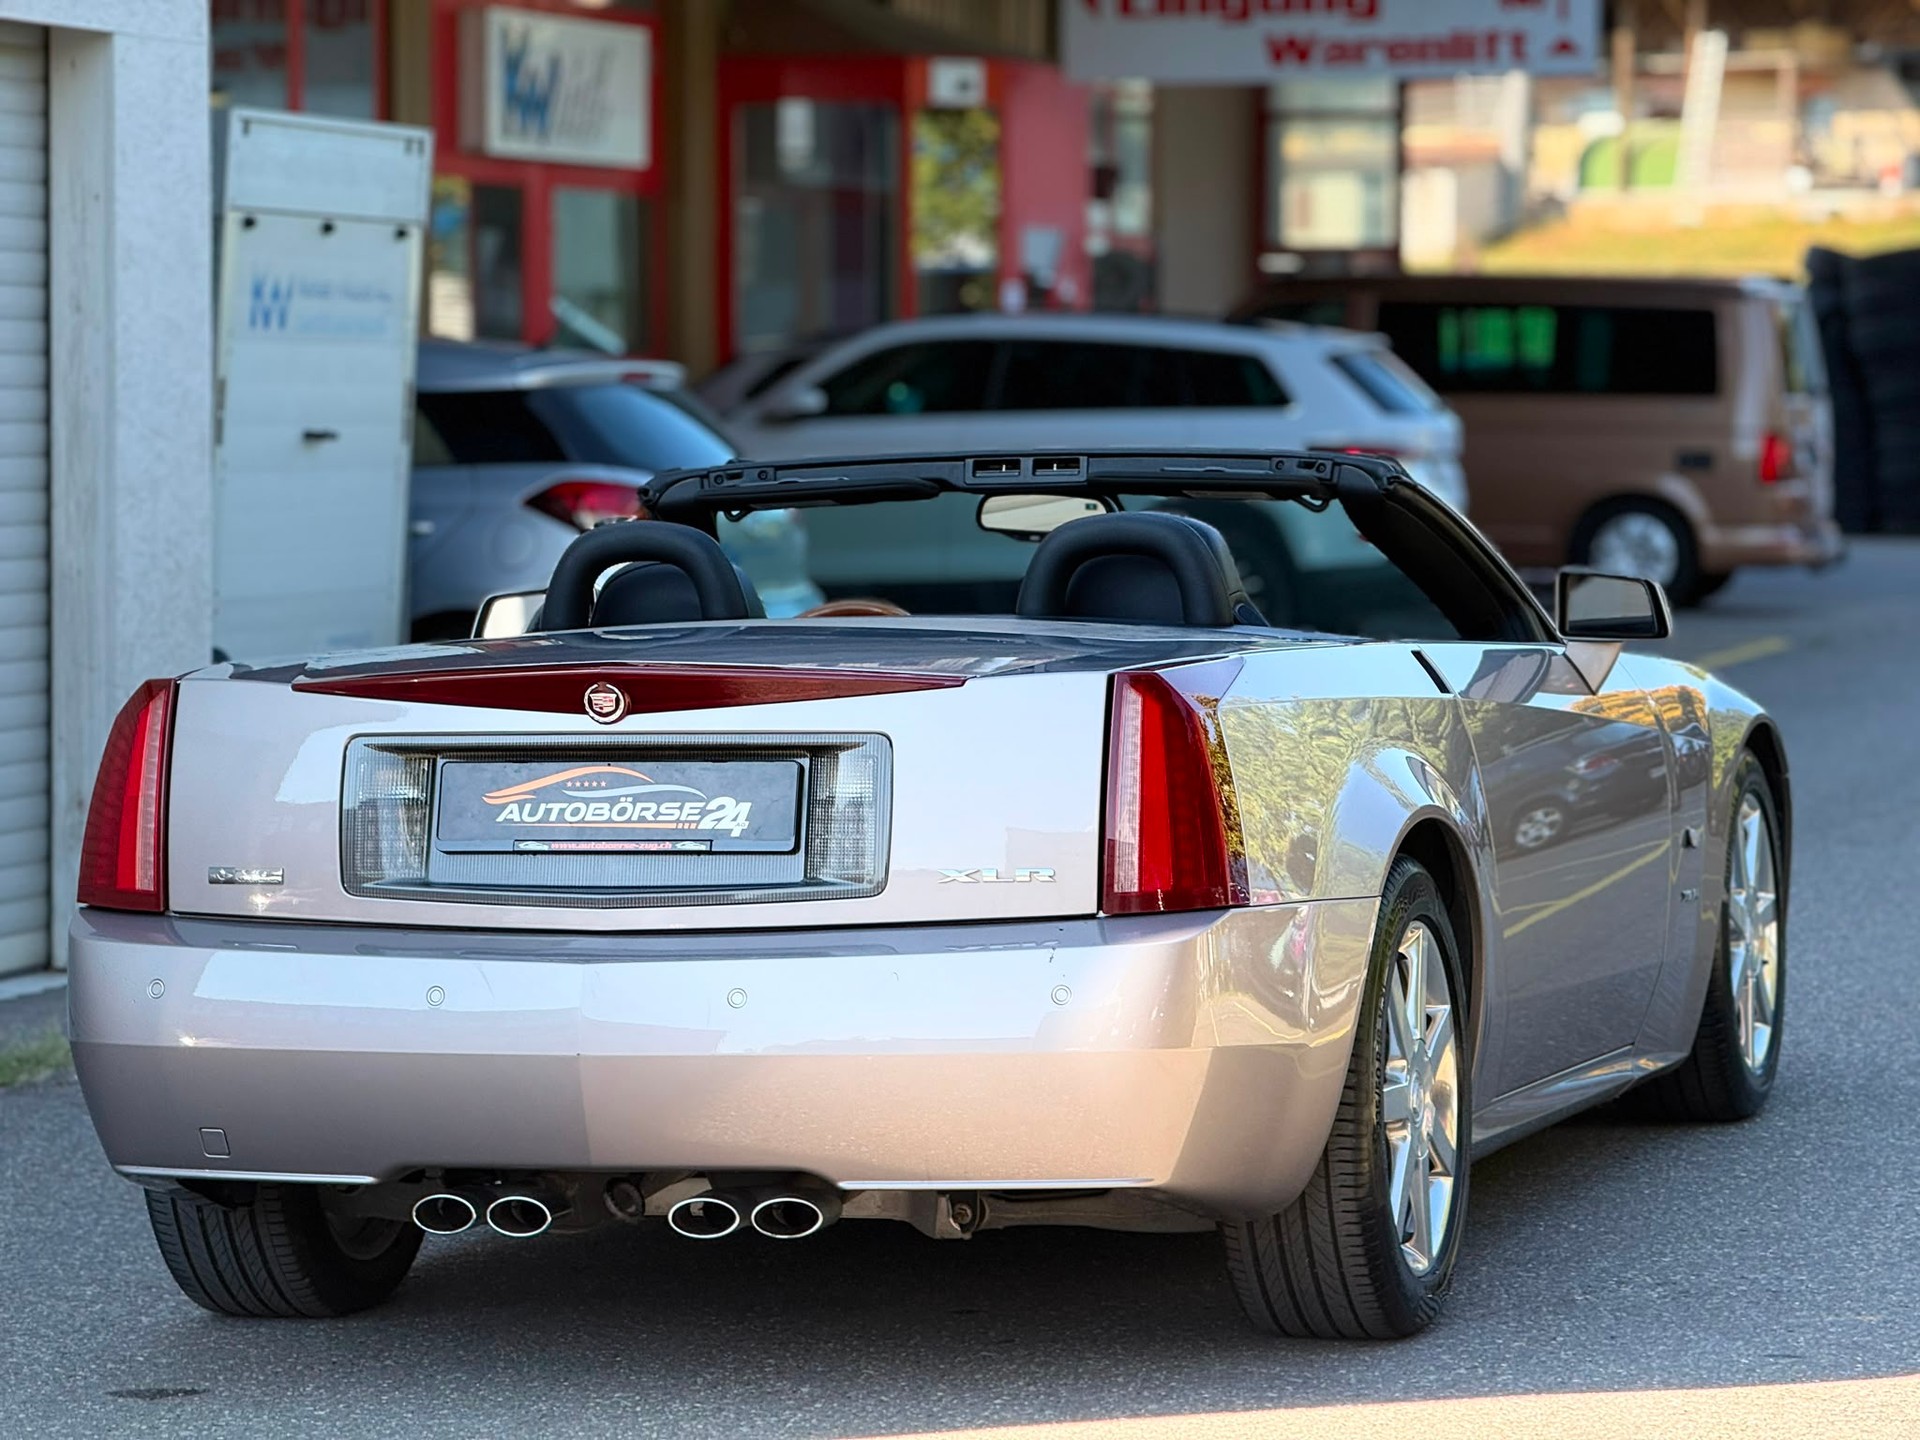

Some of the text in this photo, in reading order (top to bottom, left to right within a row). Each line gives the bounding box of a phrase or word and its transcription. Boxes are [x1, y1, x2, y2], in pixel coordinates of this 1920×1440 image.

[495, 796, 753, 838] AUTOBÖRSE 24
[937, 868, 1057, 883] XLR
